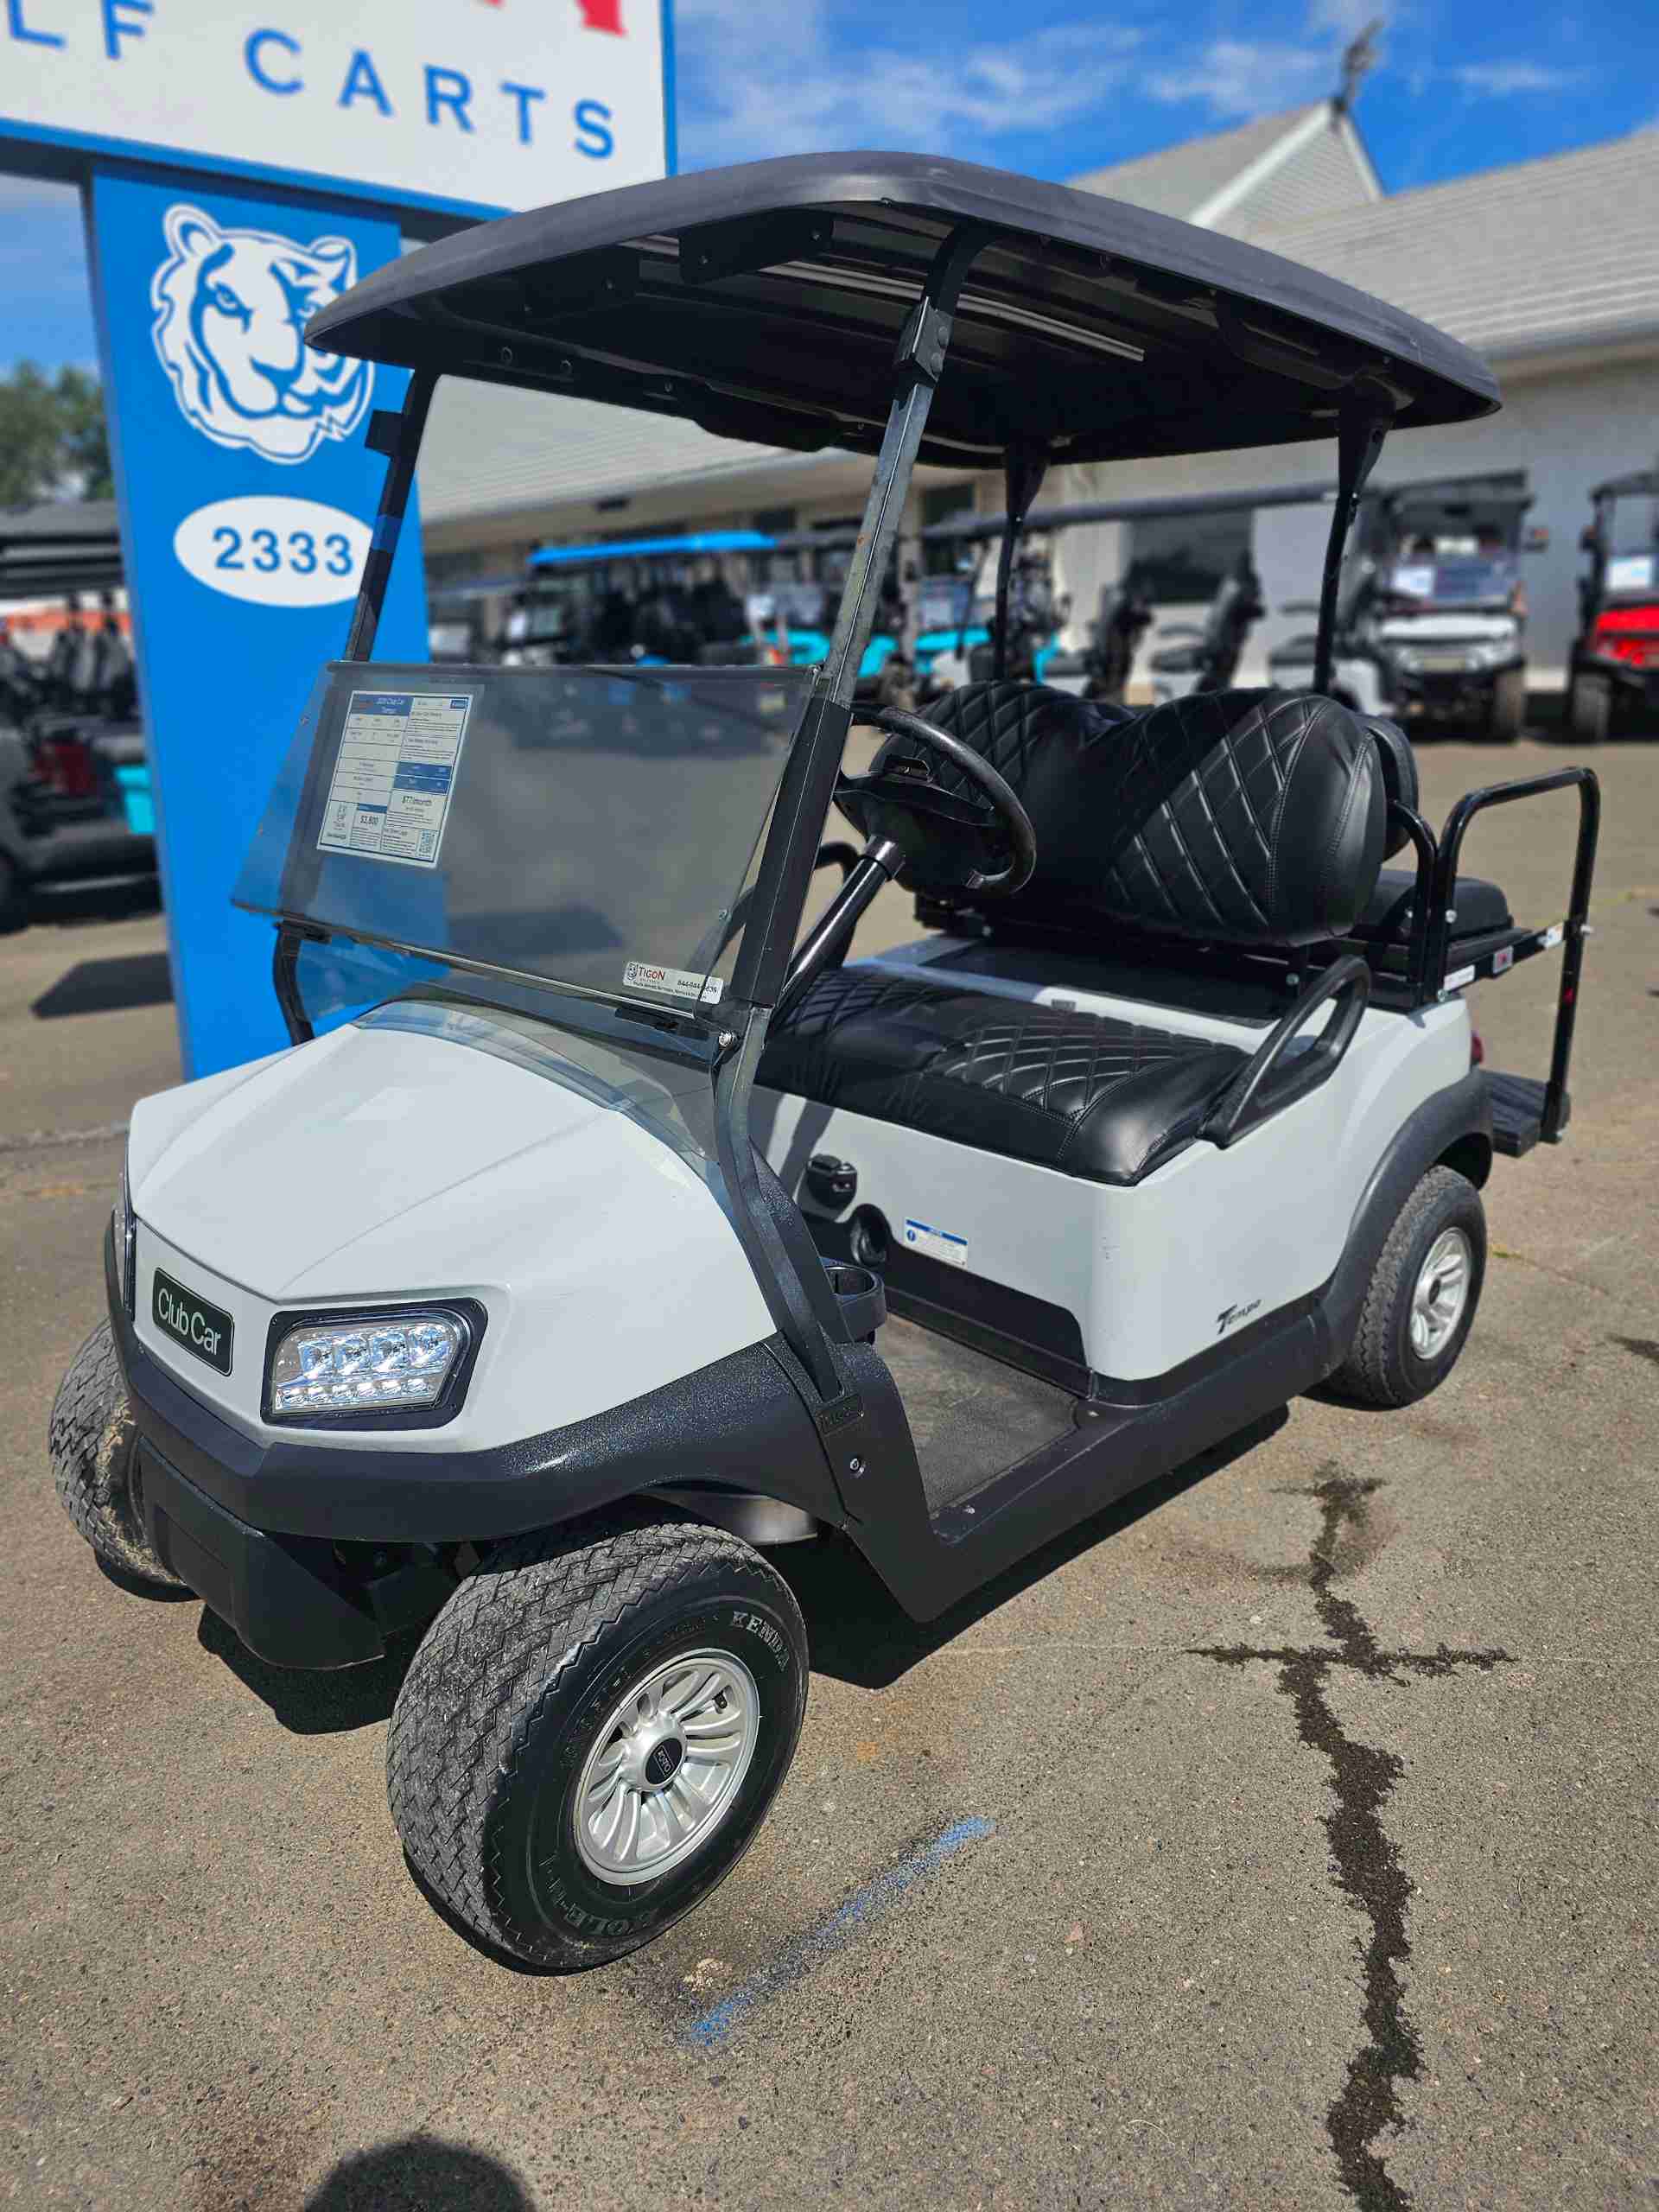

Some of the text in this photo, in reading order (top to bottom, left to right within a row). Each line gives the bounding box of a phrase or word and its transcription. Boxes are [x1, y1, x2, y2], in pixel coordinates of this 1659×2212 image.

[244, 28, 616, 161] CARTS
[212, 526, 353, 576] 2333
[639, 966, 665, 982] TIGON
[731, 1610, 791, 1673] KENDA
